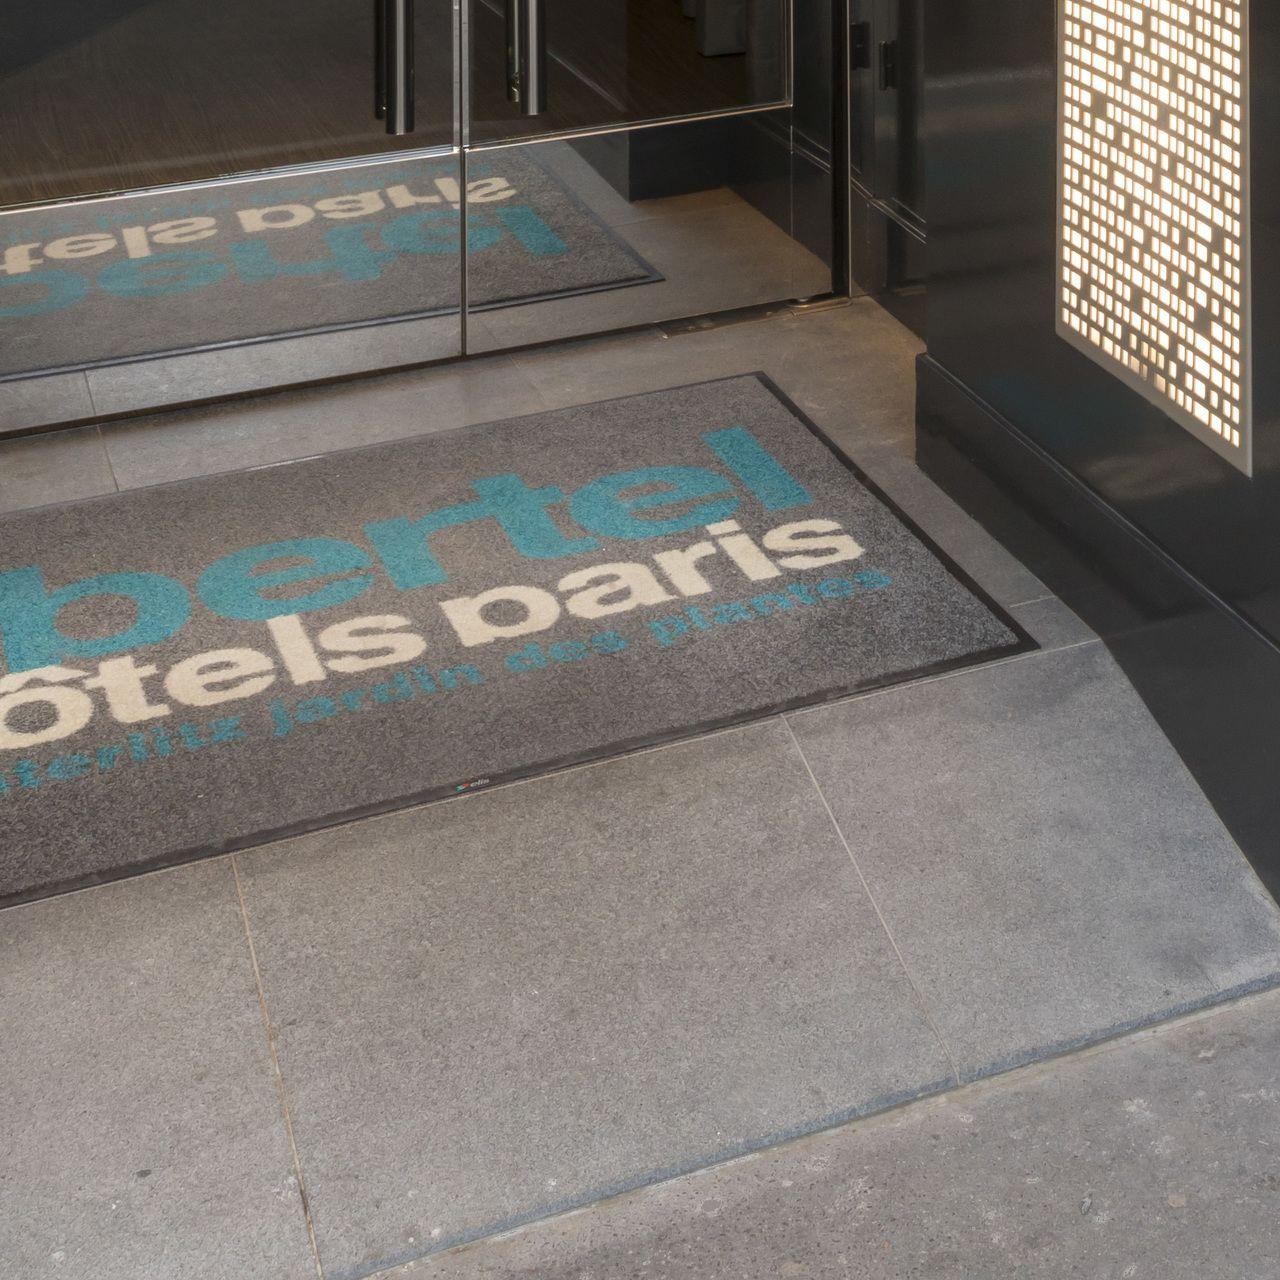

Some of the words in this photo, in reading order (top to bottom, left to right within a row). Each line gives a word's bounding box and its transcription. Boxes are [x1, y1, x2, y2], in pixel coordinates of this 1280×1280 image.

[266, 661, 485, 738] jardin
[504, 629, 627, 673] des
[648, 568, 893, 647] plantes
[444, 517, 866, 647] paris
